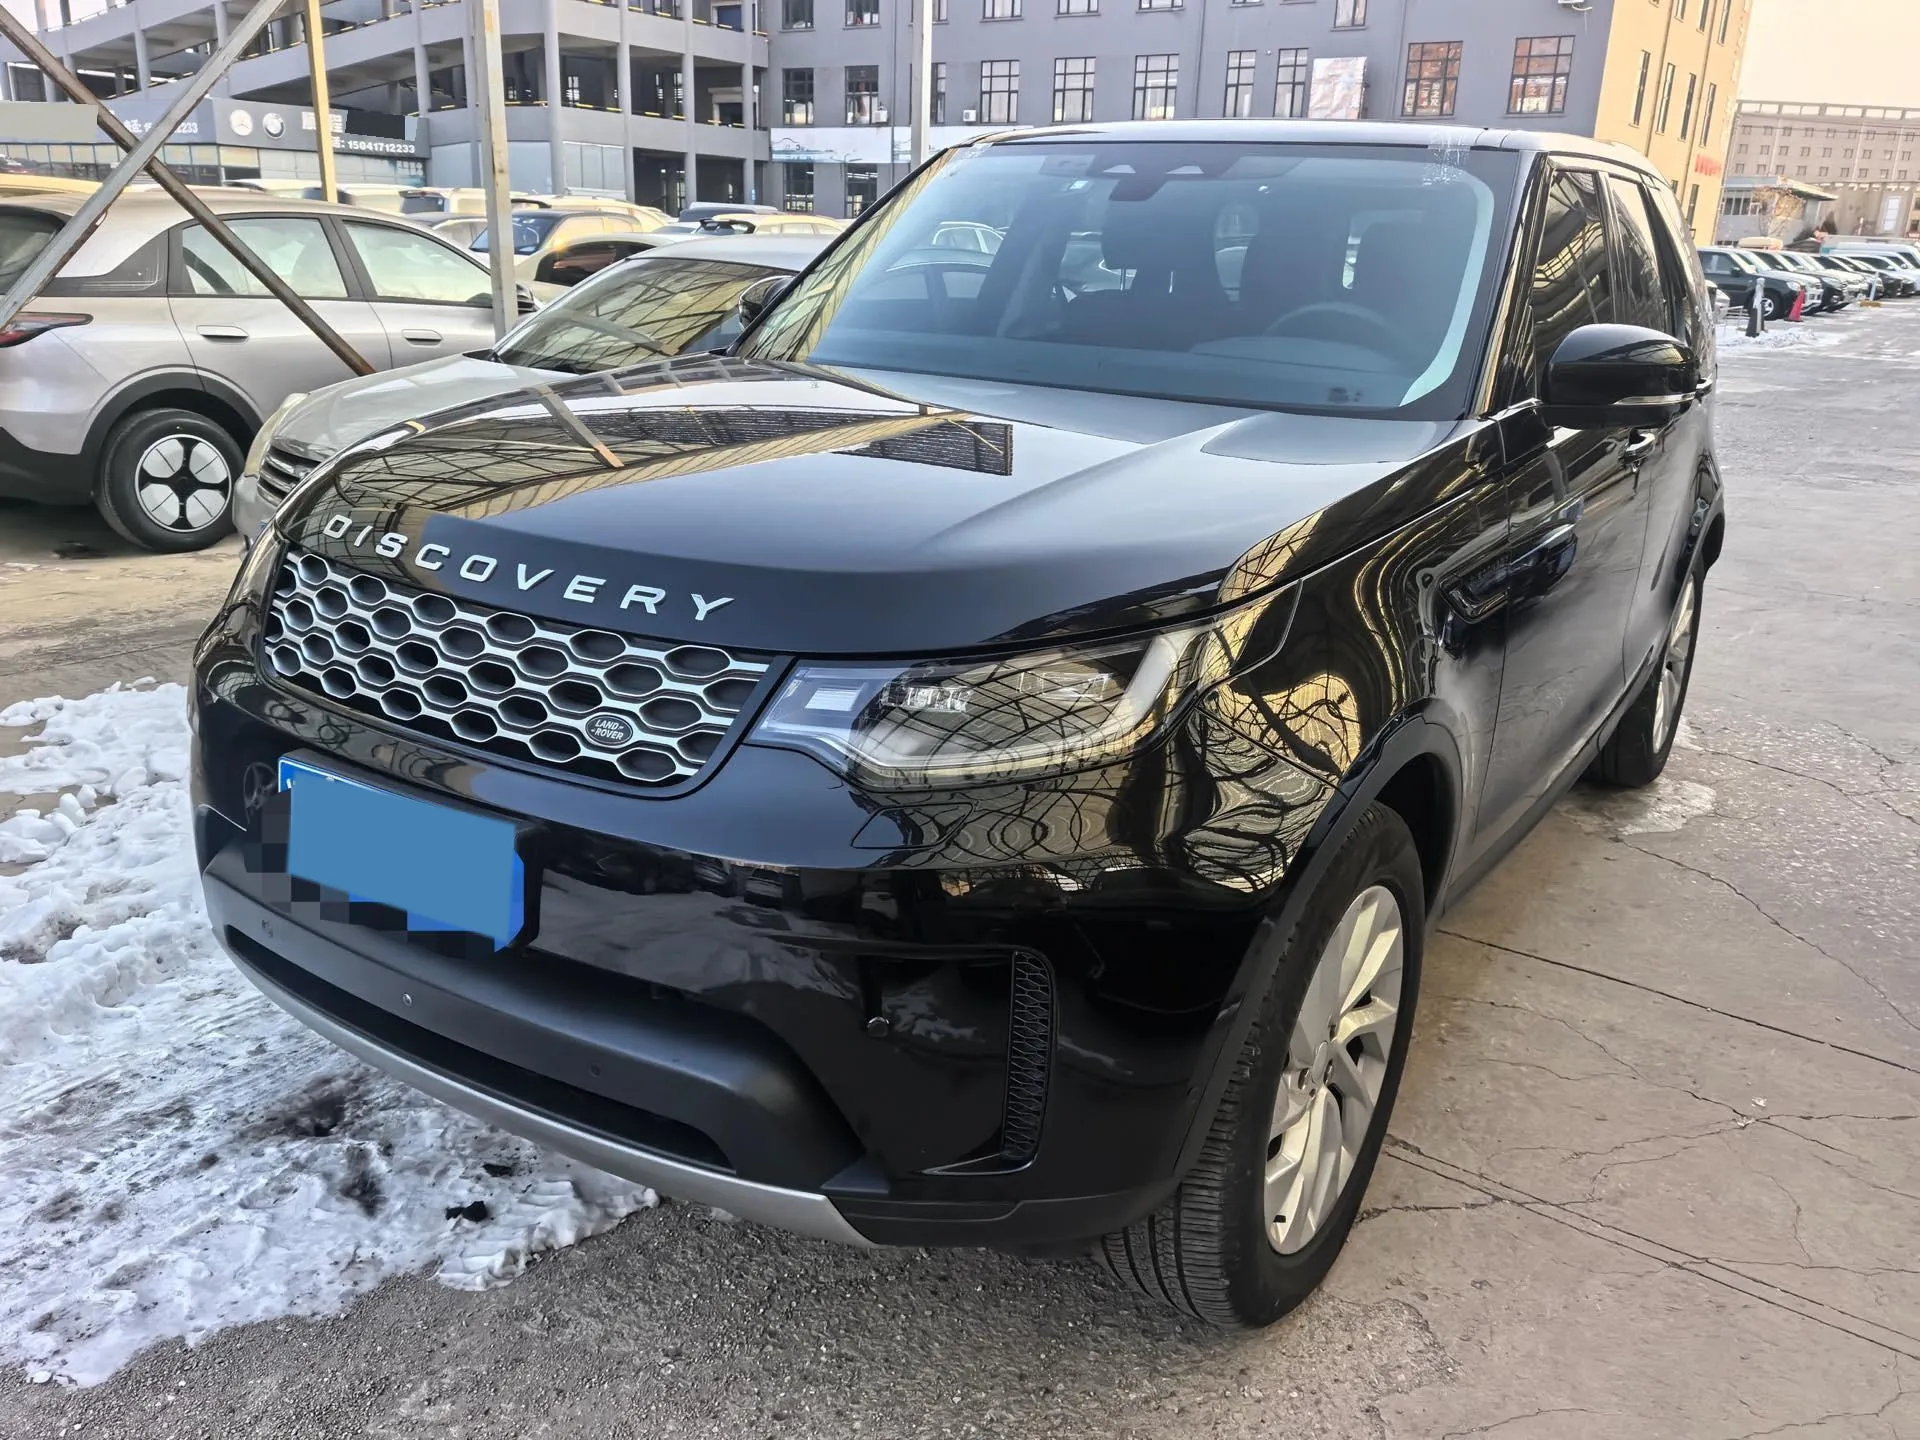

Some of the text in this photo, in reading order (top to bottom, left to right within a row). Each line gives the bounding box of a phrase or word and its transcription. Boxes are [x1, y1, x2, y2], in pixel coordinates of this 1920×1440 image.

[322, 514, 735, 622] DISCOVERY
[595, 720, 619, 730] LAND
[595, 728, 624, 740] ROVER
